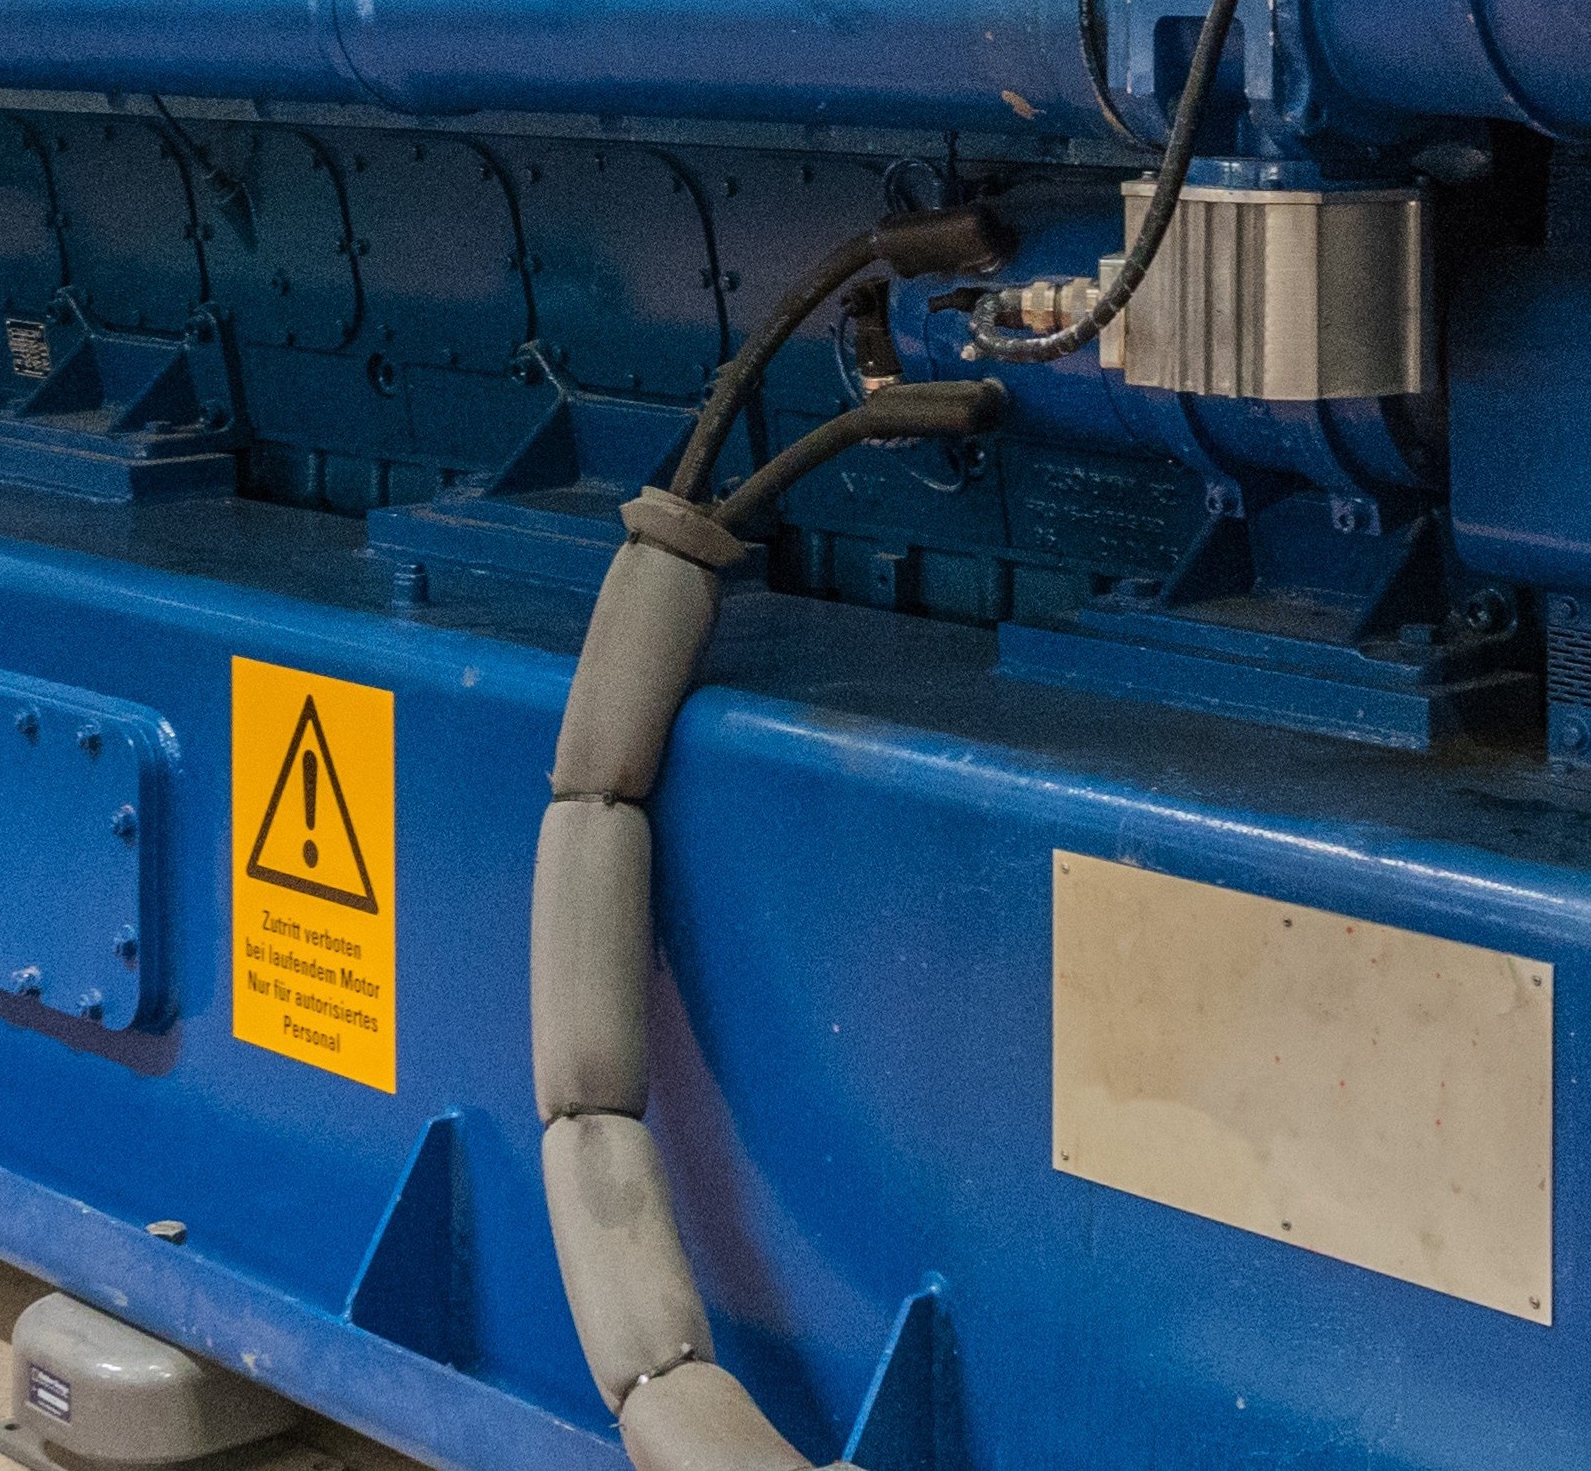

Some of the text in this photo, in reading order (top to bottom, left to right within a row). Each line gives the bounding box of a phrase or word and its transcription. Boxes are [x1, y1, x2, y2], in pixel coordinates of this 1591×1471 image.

[263, 910, 362, 960] Zutritt verboten
[246, 936, 380, 1000] bei laufendem Motor
[248, 970, 379, 1033] Nur für autorisiertes
[284, 1015, 341, 1054] Personal
